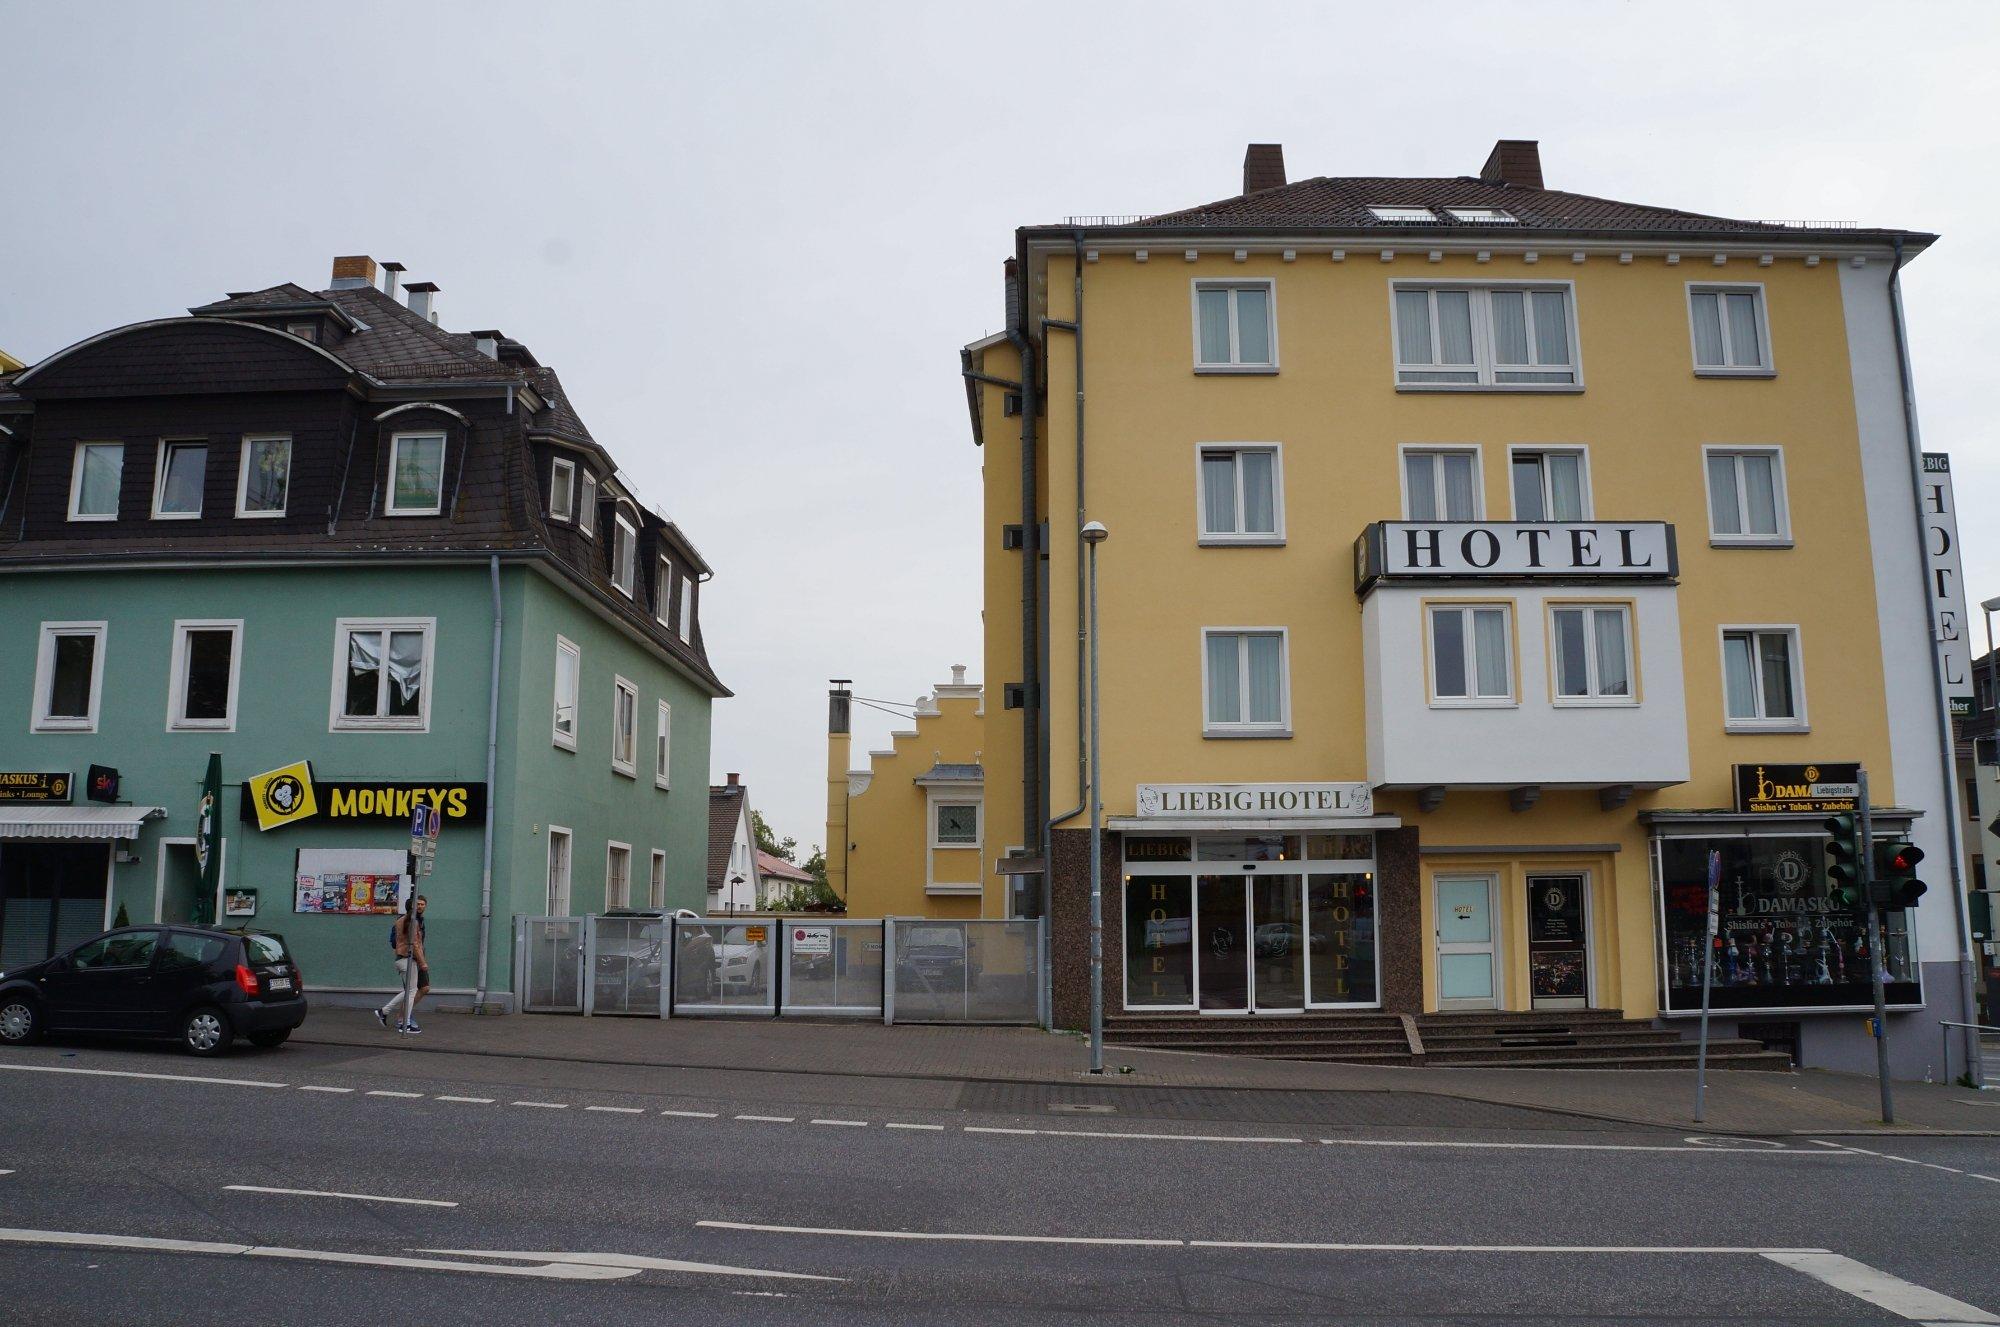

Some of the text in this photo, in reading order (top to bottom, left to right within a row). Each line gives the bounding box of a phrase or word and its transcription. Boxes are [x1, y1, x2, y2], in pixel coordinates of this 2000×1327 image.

[1401, 528, 1652, 568] HOTEL
[1949, 699, 1970, 711] her
[21, 790, 49, 800] Lounge
[1816, 785, 1853, 796] Liebigstraße
[330, 787, 467, 817] MONKEYS
[1161, 789, 1350, 811] LIEBIG HOTEL
[1750, 801, 1854, 812] Shisha's Tabak Zubehör
[414, 808, 423, 832] P
[1128, 843, 1186, 856] LIEBIG
[1783, 861, 1799, 880] D
[1454, 905, 1473, 913] HOTEL
[1758, 897, 1848, 912] DAMASKU
[1727, 920, 1765, 930] Shisha's
[1150, 884, 1166, 997] HOTEL
[1332, 882, 1350, 995] HOTEL
